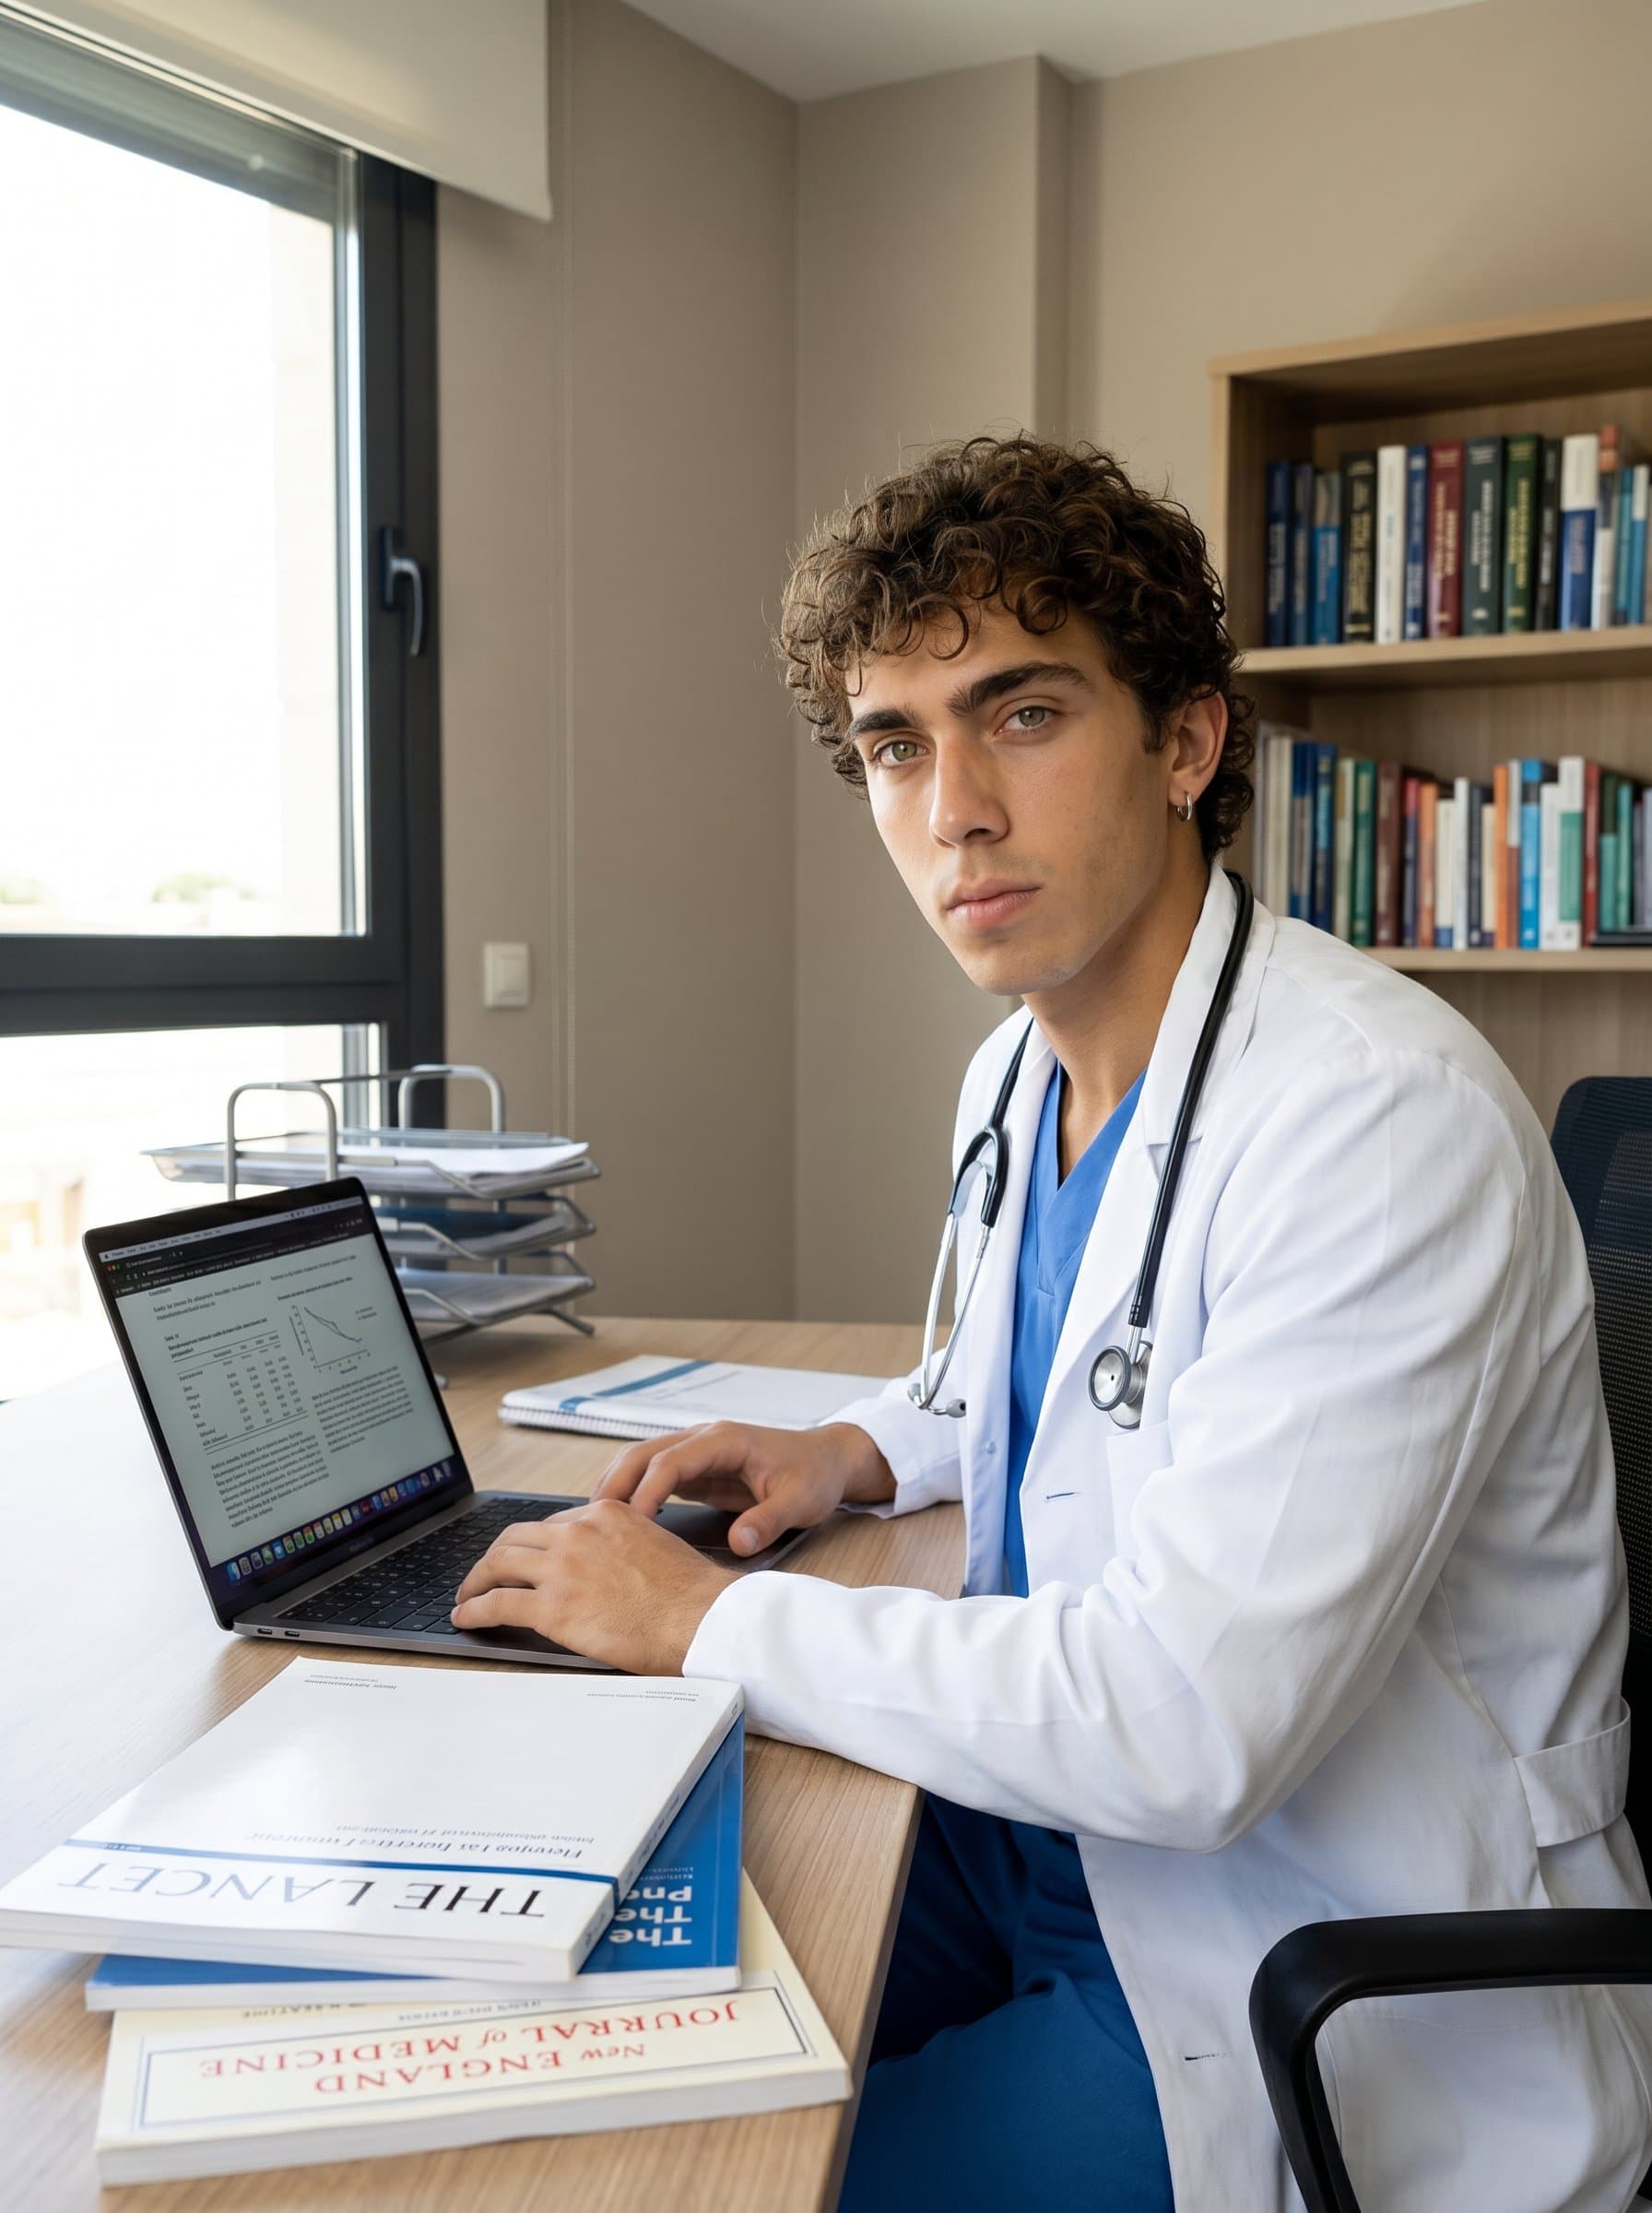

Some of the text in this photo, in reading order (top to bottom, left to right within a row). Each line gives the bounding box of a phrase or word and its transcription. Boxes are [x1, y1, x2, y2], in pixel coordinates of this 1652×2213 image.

[58, 1862, 545, 1918] THE LANCET
[615, 1905, 692, 1924] The
[609, 1925, 692, 1947] The
[477, 2028, 507, 2049] of
[199, 2034, 461, 2077] MEDICINE
[313, 2043, 645, 2094] New ENGLAND
